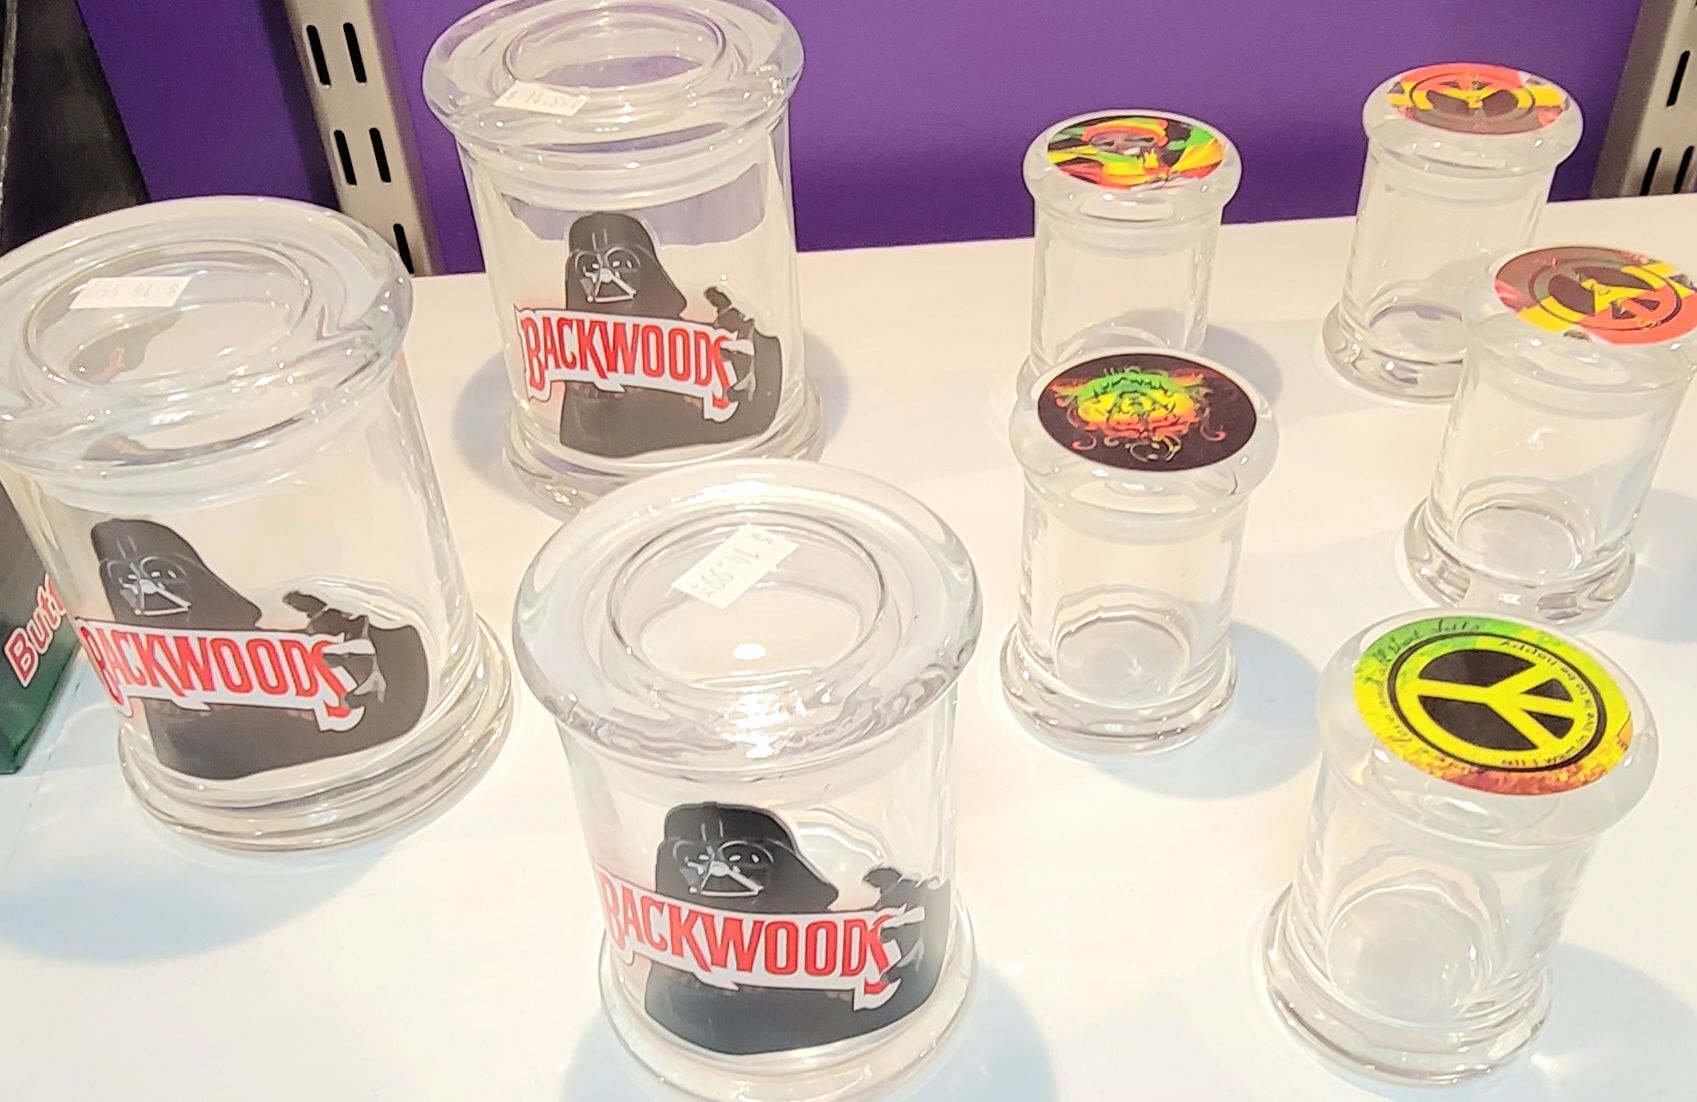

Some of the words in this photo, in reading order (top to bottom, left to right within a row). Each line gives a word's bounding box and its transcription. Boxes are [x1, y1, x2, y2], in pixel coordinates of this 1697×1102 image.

[518, 315, 736, 412] BACKWOODS
[79, 624, 354, 720] BACKWOODS
[597, 871, 895, 997] BACKWOODS
